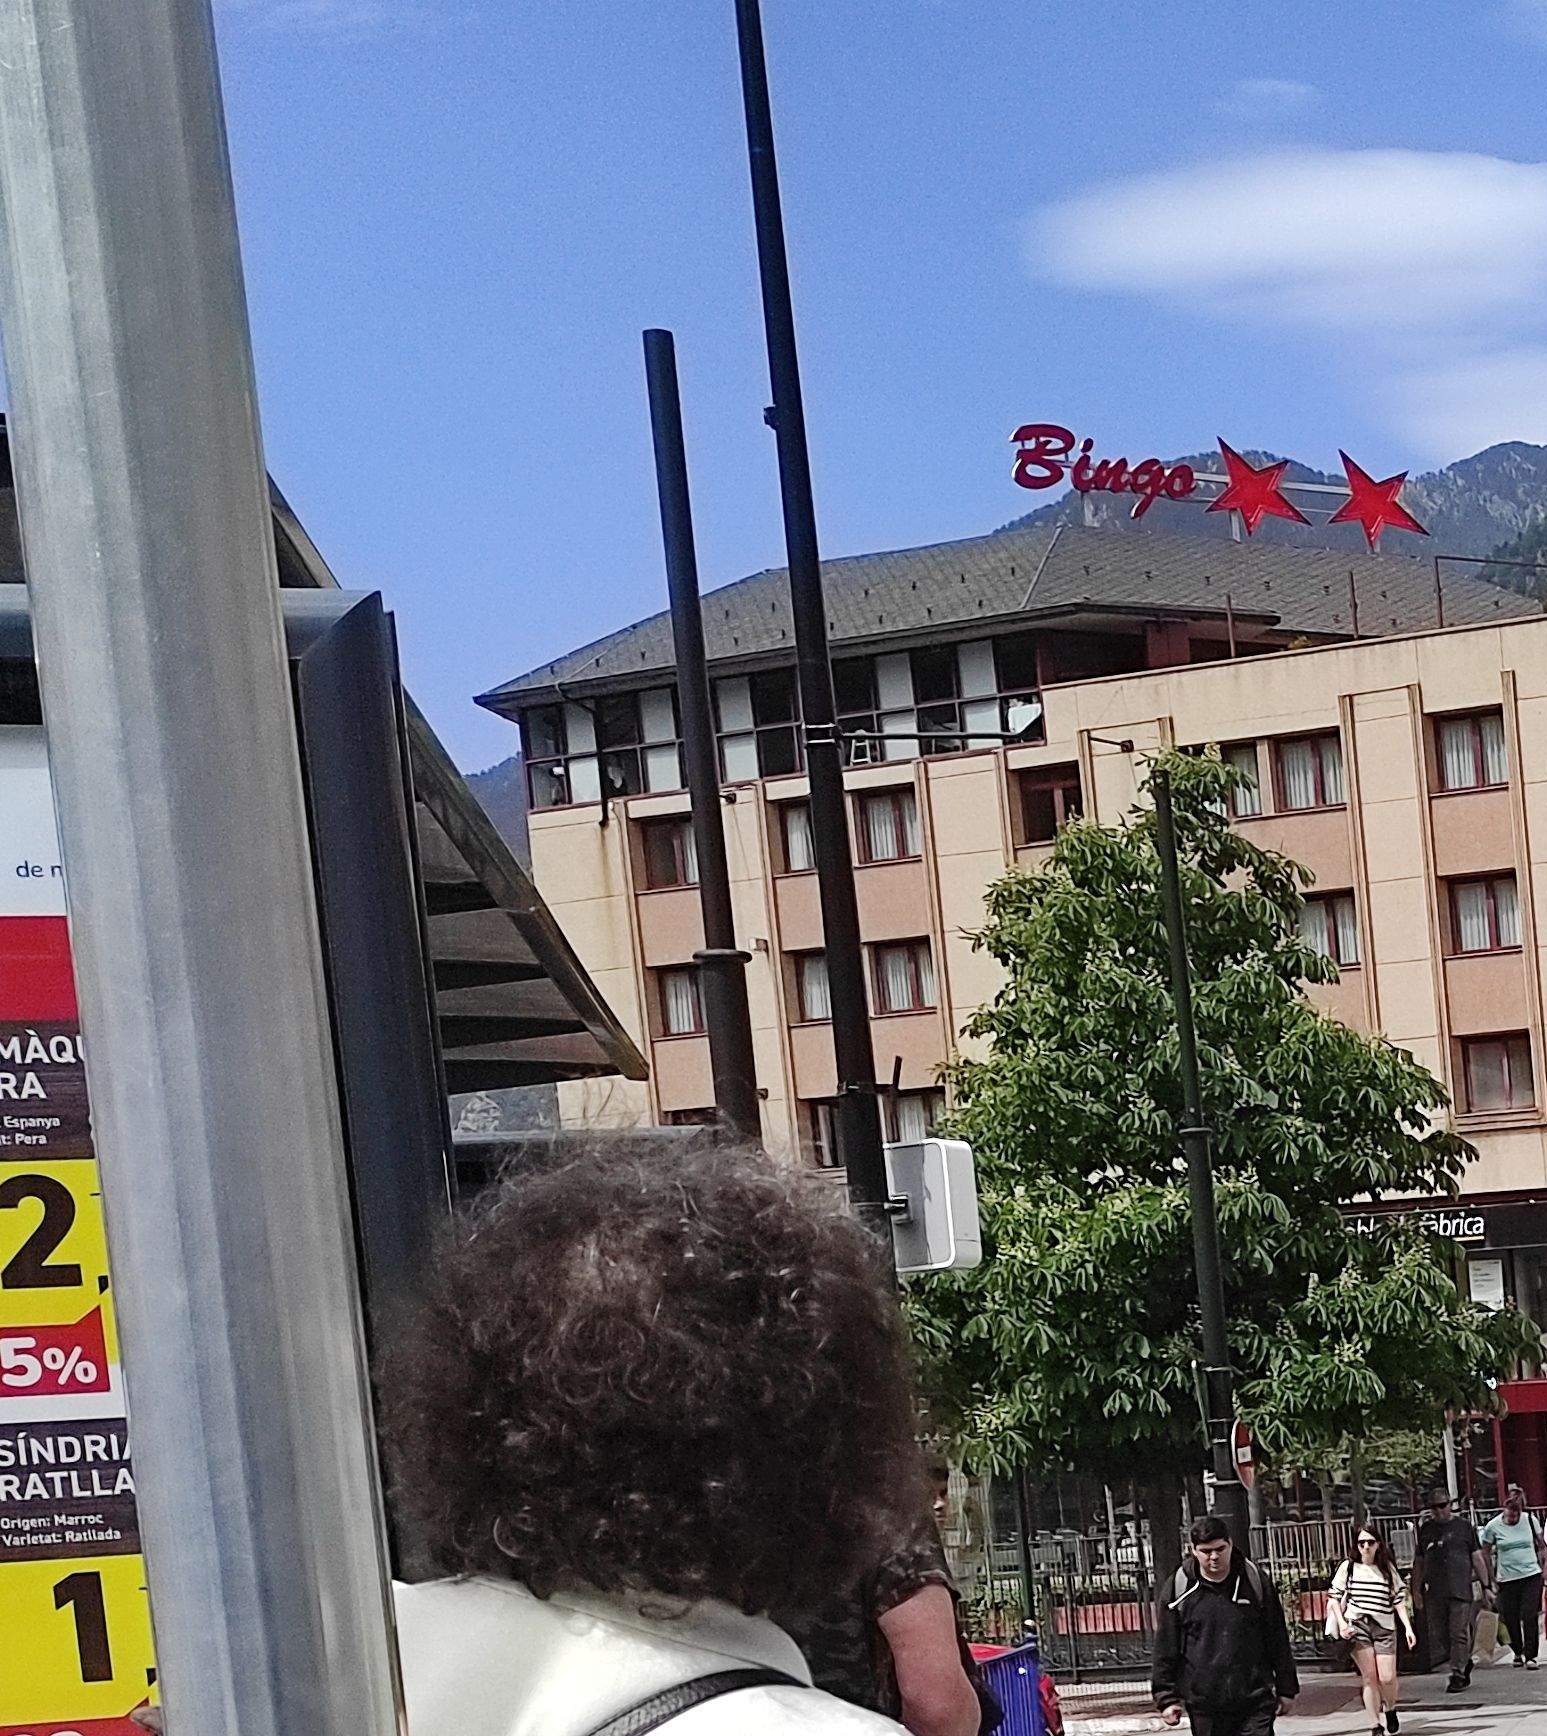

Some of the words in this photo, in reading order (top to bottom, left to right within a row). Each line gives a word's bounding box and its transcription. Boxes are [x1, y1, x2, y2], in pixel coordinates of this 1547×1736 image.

[1009, 423, 1197, 519] Bingo
[16, 860, 43, 878] de
[3, 1116, 61, 1131] Espanya
[15, 1132, 47, 1145] Pera
[0, 1517, 50, 1531] Origen:
[54, 1513, 104, 1526] Marroc
[1, 1532, 62, 1547] Varietat:
[65, 1527, 122, 1542] Ratllada
